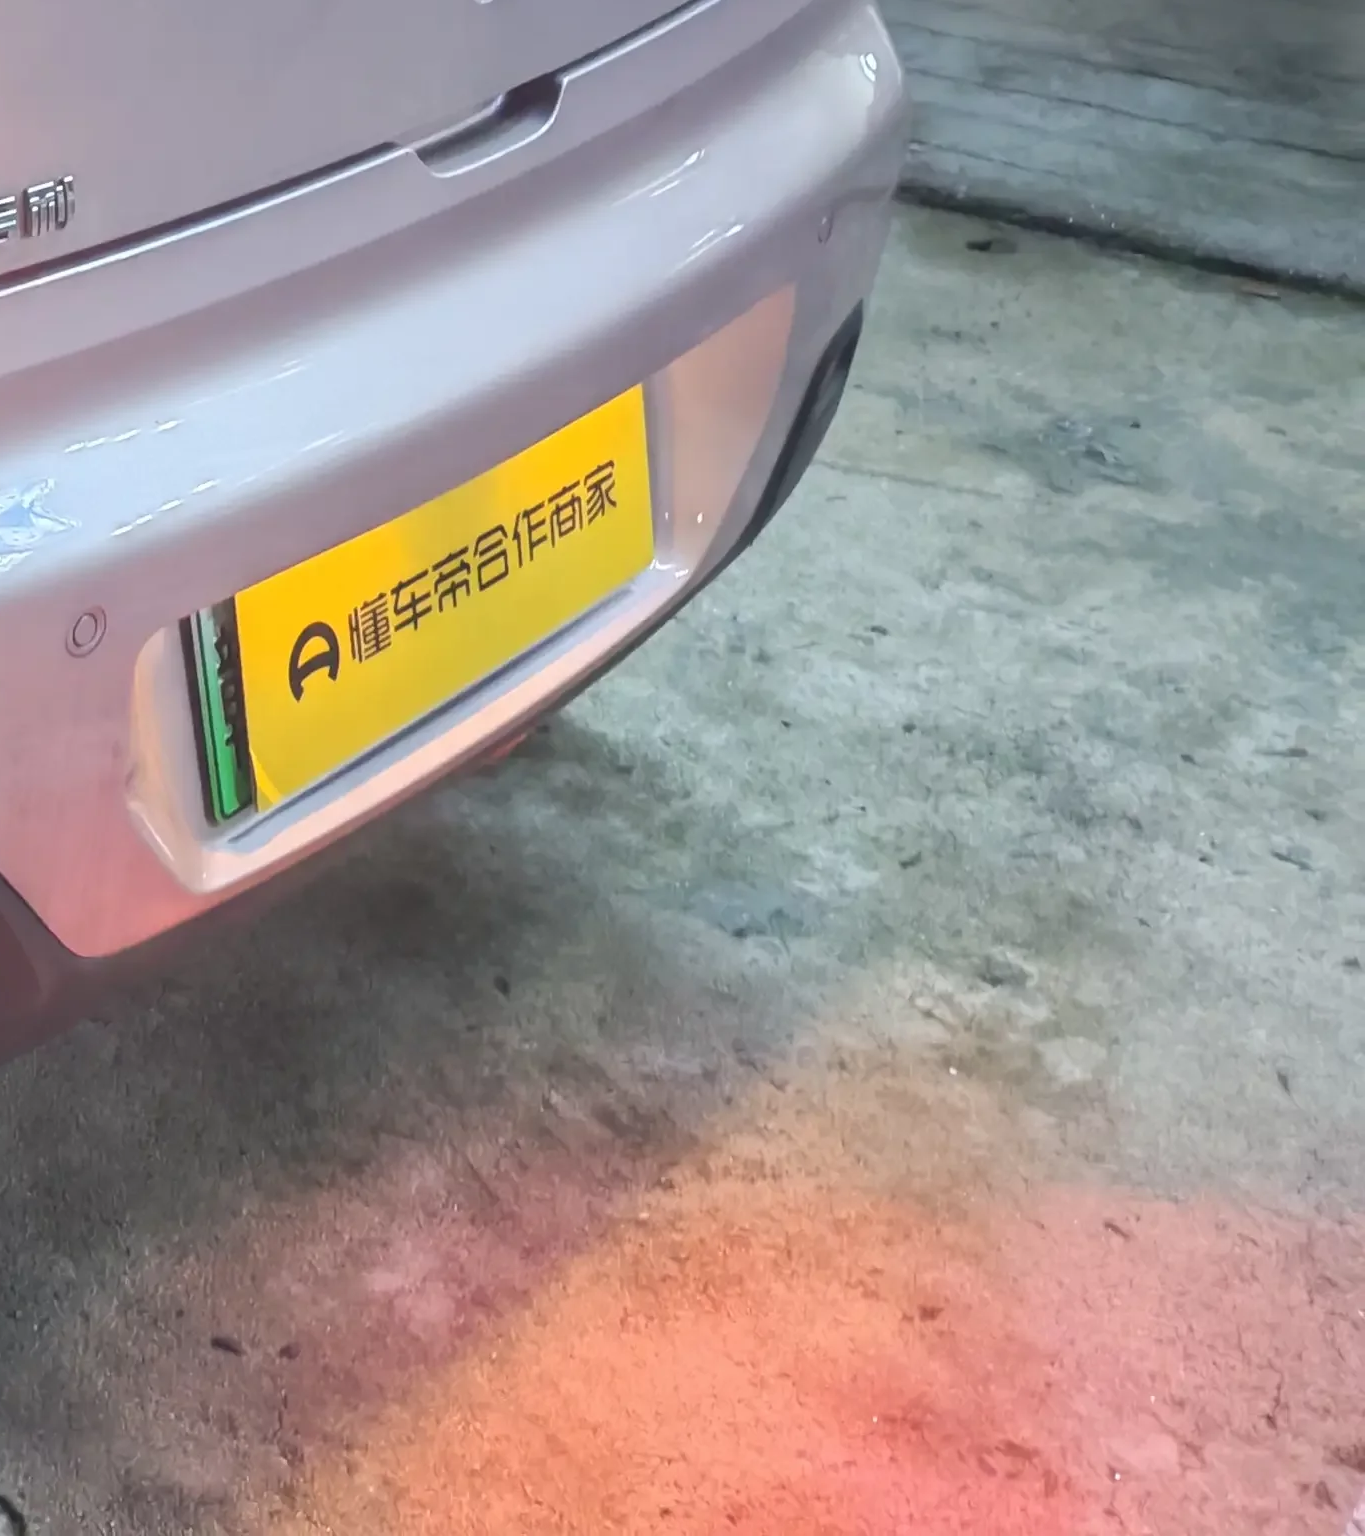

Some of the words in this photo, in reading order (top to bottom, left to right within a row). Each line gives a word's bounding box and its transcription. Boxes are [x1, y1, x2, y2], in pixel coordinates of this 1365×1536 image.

[348, 459, 619, 665] 懂车帝合作商家
